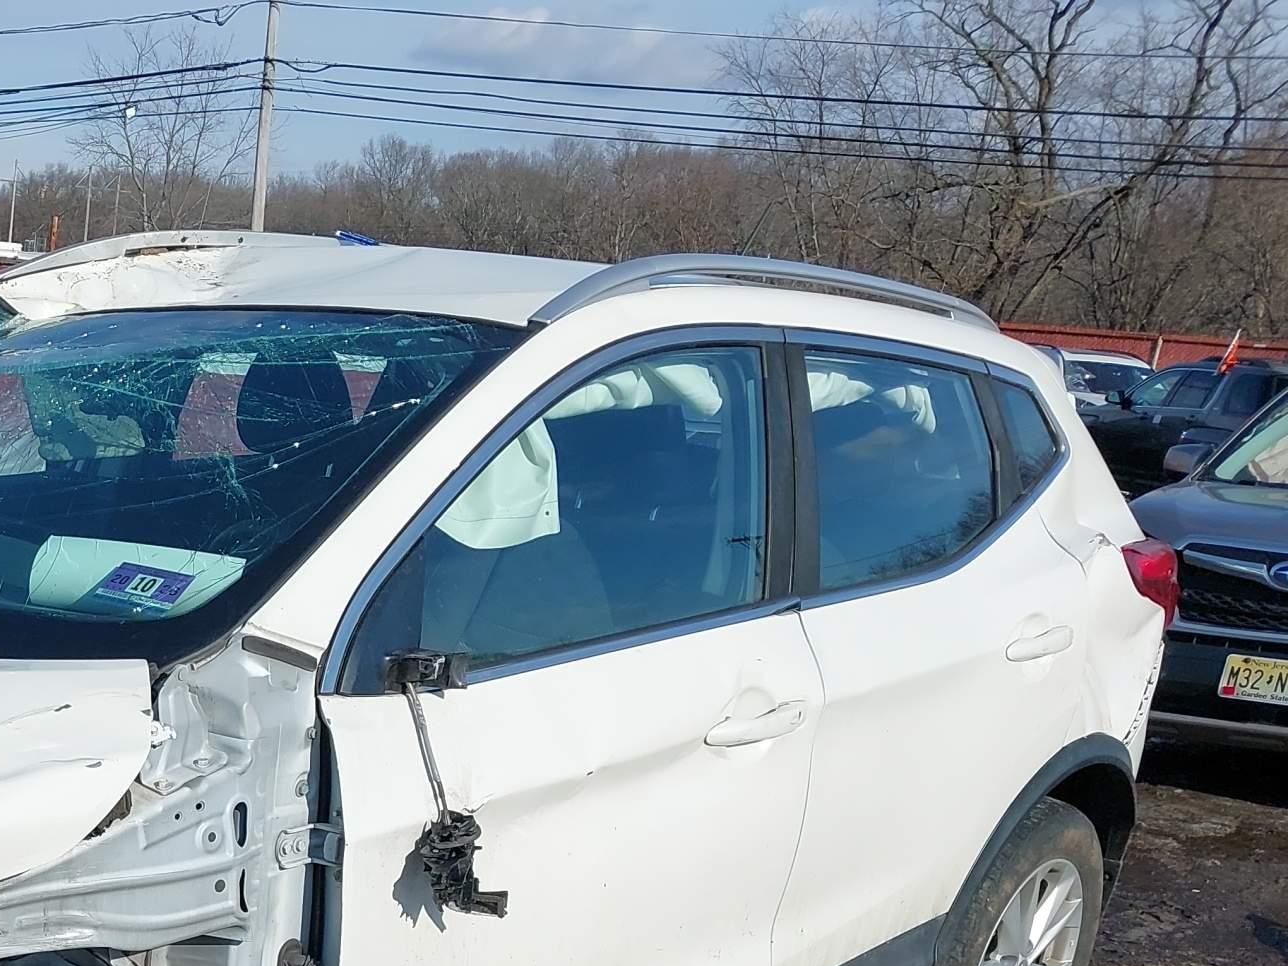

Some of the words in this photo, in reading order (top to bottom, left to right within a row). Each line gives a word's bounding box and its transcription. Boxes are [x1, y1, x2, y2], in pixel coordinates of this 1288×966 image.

[110, 574, 130, 585] 20
[130, 576, 157, 593] 10
[1226, 665, 1264, 691] M32
[1273, 671, 1288, 694] N
